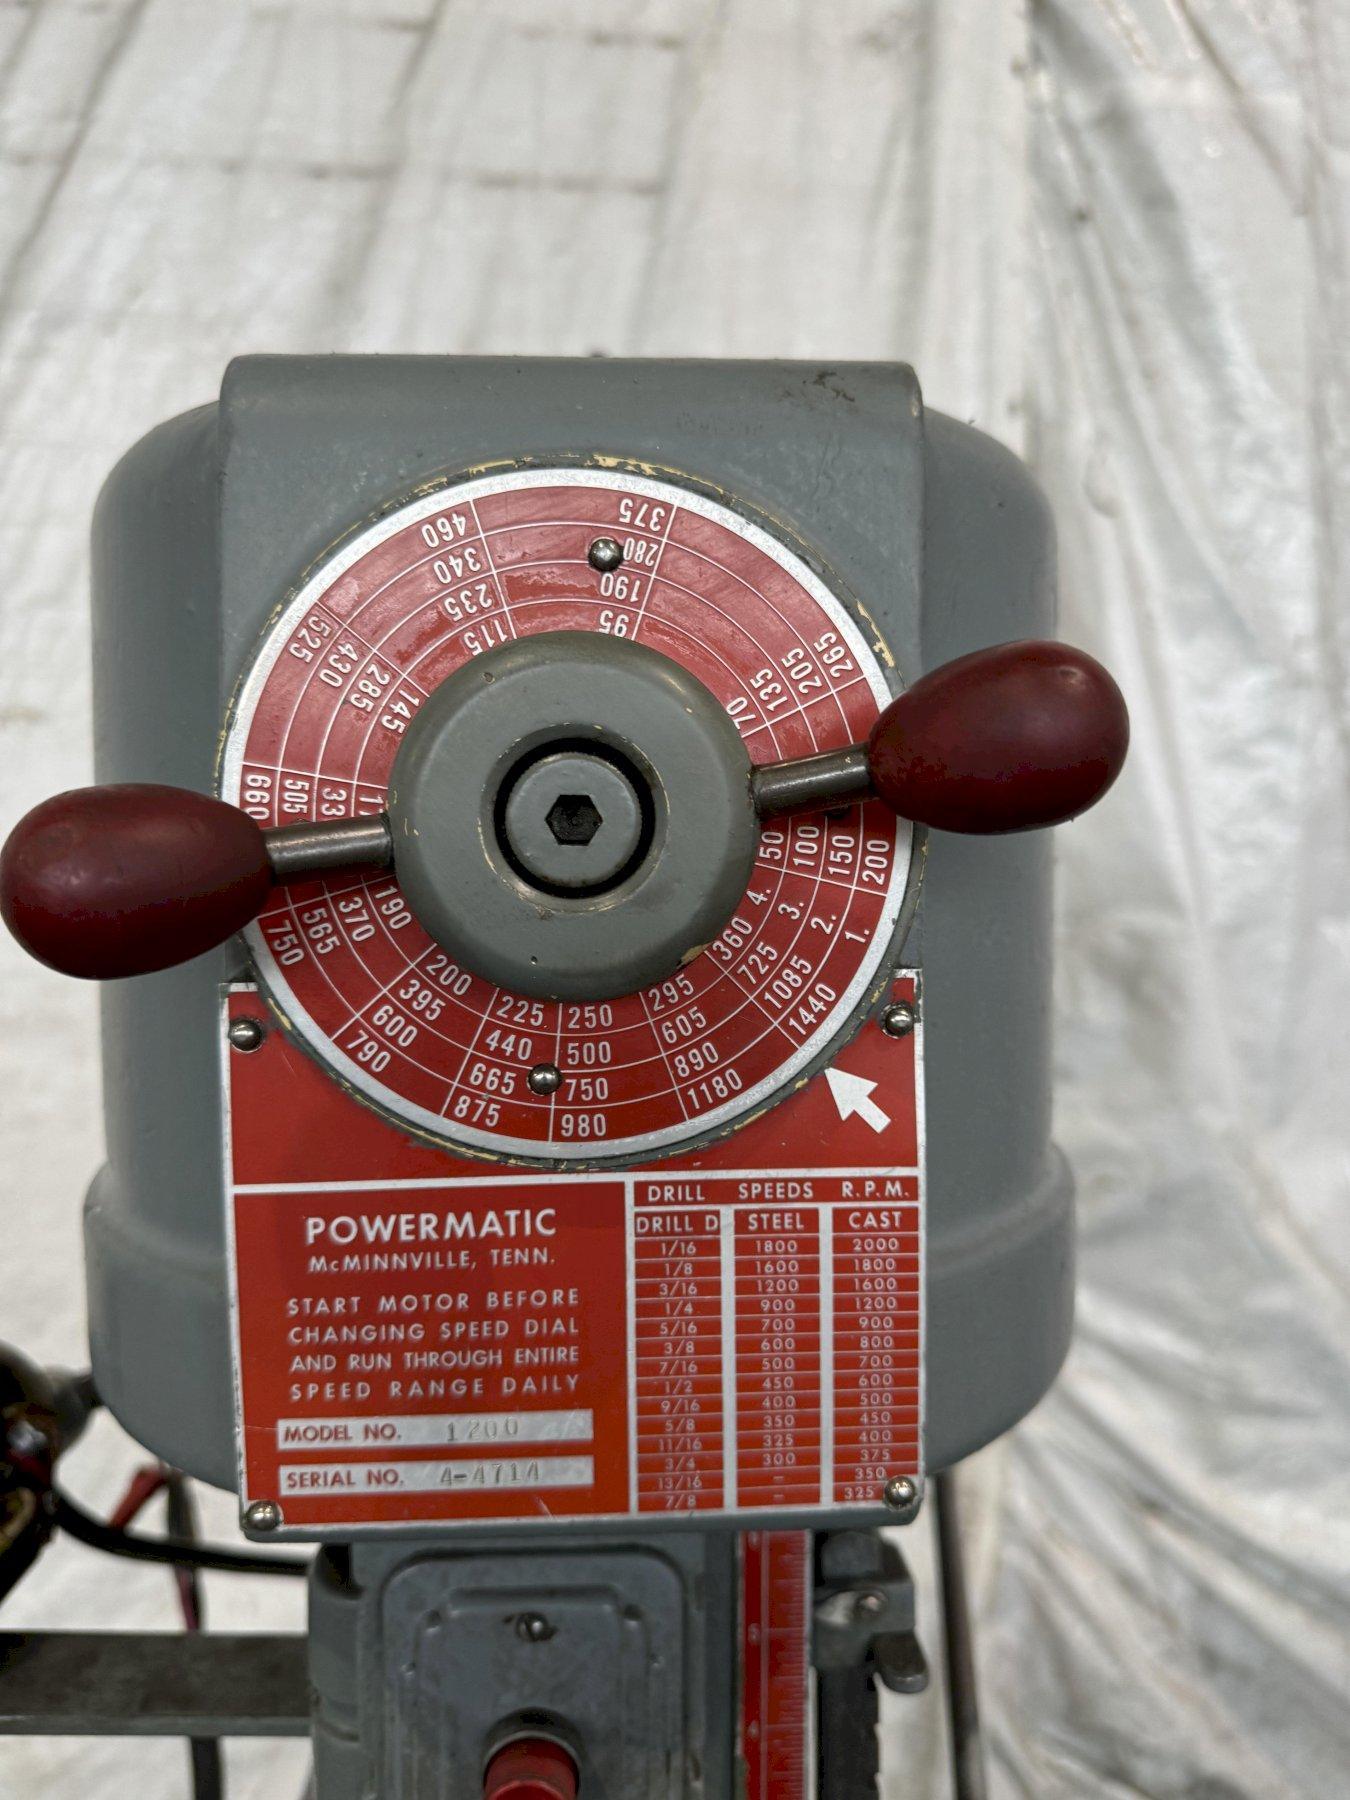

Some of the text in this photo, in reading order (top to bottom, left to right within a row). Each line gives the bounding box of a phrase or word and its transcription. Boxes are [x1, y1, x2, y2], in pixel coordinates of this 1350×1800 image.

[422, 512, 466, 548] 460
[619, 498, 665, 531] 375
[433, 547, 482, 584] 340
[623, 538, 658, 566] 280
[444, 584, 492, 621] 235
[600, 574, 641, 602] 190
[289, 615, 331, 662] 525
[464, 620, 507, 656] 115
[599, 610, 629, 637] 95
[319, 643, 359, 688] 430
[814, 632, 853, 678] 265
[782, 648, 822, 694] 205
[350, 664, 390, 713] 285
[750, 669, 788, 711] 135
[382, 689, 420, 733] 145
[726, 697, 755, 729] 70
[245, 774, 271, 820] 660
[283, 780, 309, 813] 505
[322, 788, 347, 816] 33
[759, 831, 784, 860] 50
[793, 826, 819, 867] 100
[828, 835, 854, 875] 150
[862, 840, 889, 885] 200
[339, 897, 375, 941] 370
[374, 885, 412, 929] 190
[267, 919, 304, 965] 750
[302, 908, 340, 954] 565
[713, 917, 752, 961] 360
[426, 955, 472, 995] 200
[737, 942, 778, 985] 725
[649, 974, 694, 1011] 295
[765, 956, 812, 1009] 1085
[399, 980, 446, 1021] 395
[497, 997, 543, 1025] 225
[789, 983, 836, 1035] 1440
[373, 1005, 418, 1047] 600
[568, 1005, 613, 1029] 250
[662, 1007, 706, 1043] 605
[346, 1030, 391, 1071] 790
[485, 1030, 532, 1060] 440
[567, 1042, 611, 1064] 500
[674, 1043, 718, 1077] 890
[469, 1063, 516, 1094] 665
[565, 1078, 608, 1100] 750
[688, 1069, 742, 1109] 1180
[454, 1096, 500, 1126] 875
[561, 1114, 606, 1137] 980
[648, 1181, 909, 1201] DRILL SPEEDS R.P.M.
[305, 1208, 557, 1245] POWERMATIC
[637, 1212, 902, 1233] DRILL D STEEL CAST
[308, 1248, 555, 1272] McMINNVILLE, TENN.
[662, 1238, 898, 1255] 1/16 1800 2000
[665, 1258, 896, 1276] 1/8 1600 1800
[287, 1289, 579, 1315] START MOTOR BEFORE
[659, 1278, 897, 1297] 3/16 1200 1600
[666, 1297, 897, 1315] 1/4 900 1200
[288, 1318, 578, 1344] CHANGING SPEED DIAL
[660, 1317, 893, 1335] 5/16 700 900
[290, 1347, 579, 1372] AND RUN THROUGH ENTIRE
[664, 1336, 894, 1355] 3/8 600 800
[659, 1355, 893, 1374] 7/16 500 700
[291, 1375, 580, 1400] SPEED RANGE DAILY
[665, 1374, 893, 1394] 1/2 450 600
[661, 1393, 893, 1413] 9/16 400 500
[283, 1417, 518, 1442] MODEL NO. 1200
[665, 1412, 891, 1432] 5/8 350 450
[659, 1430, 891, 1451] 11/16 325 400
[665, 1449, 890, 1470] 3/4 300 375
[287, 1471, 355, 1488] SERIAL
[367, 1469, 403, 1486] NO.
[657, 1467, 886, 1490] 13/16 350
[666, 1486, 874, 1508] 7/8 325
